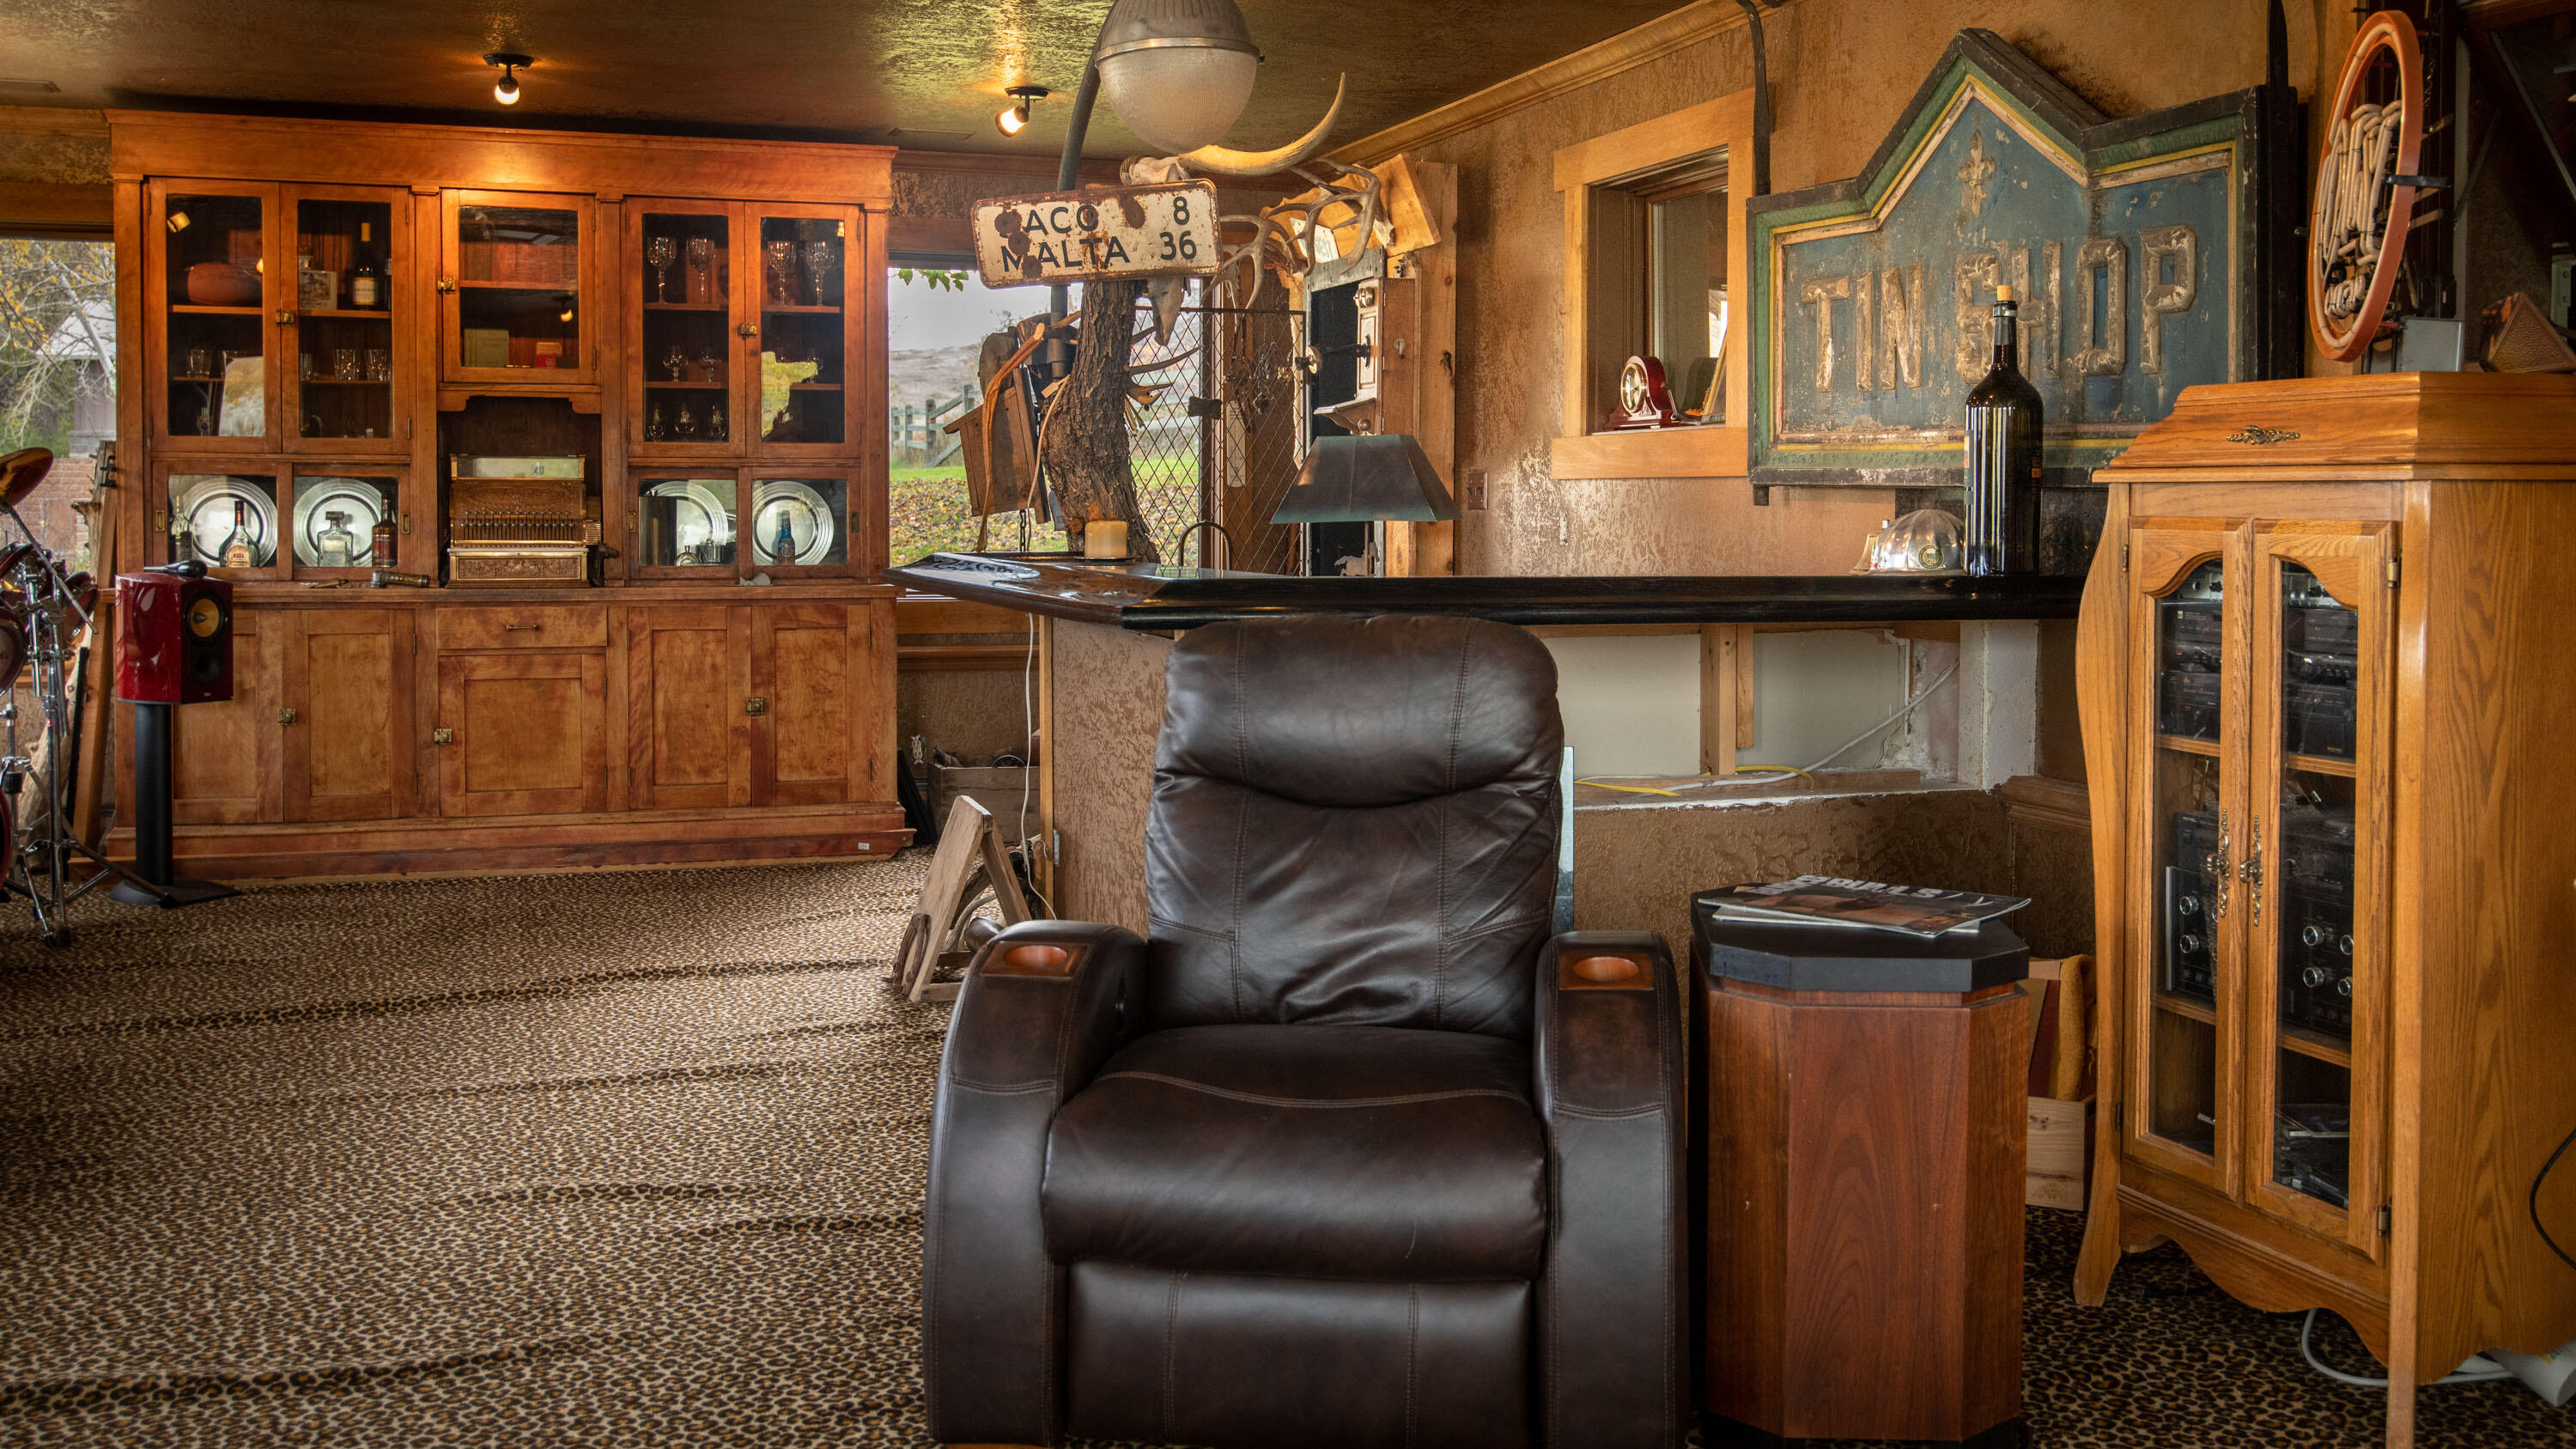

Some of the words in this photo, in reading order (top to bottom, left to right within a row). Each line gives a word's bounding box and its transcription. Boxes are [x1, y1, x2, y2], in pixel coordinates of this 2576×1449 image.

[1023, 204, 1099, 236] ACO
[1172, 196, 1191, 226] 8
[1000, 235, 1131, 273] MALTA
[1158, 230, 1197, 261] 36
[1802, 262, 1923, 393] TIN
[1955, 224, 2198, 384] SHOP
